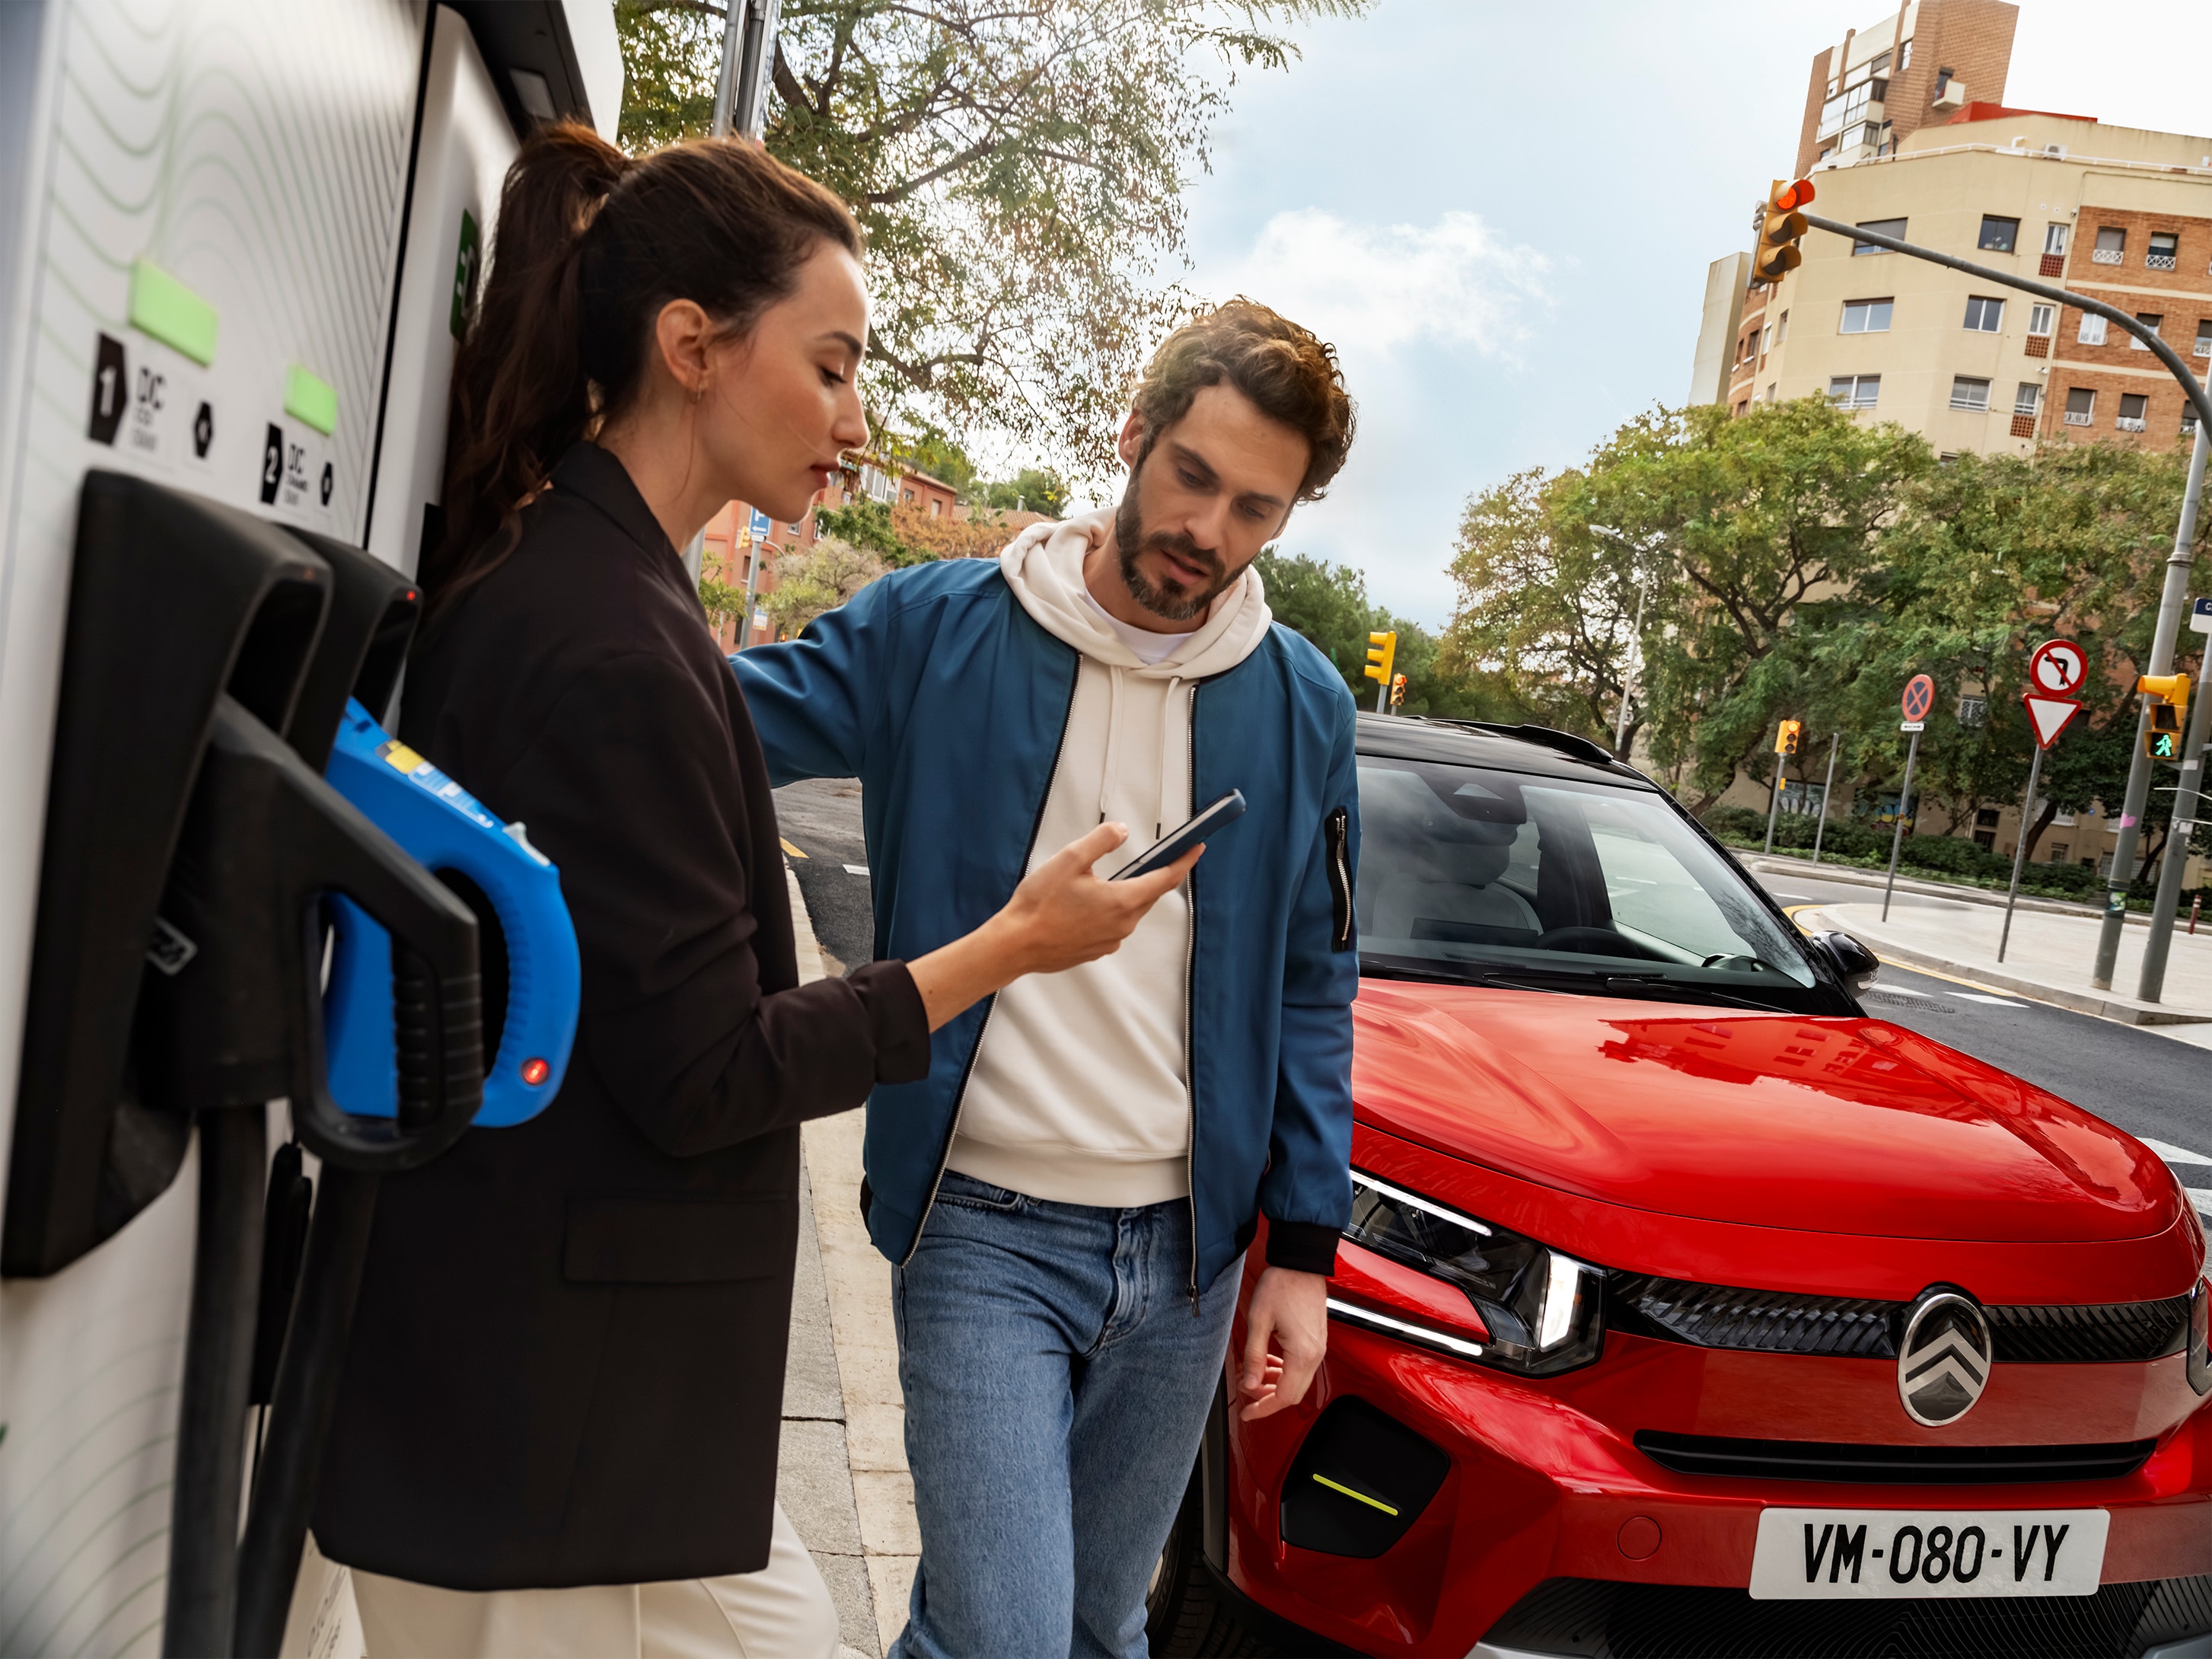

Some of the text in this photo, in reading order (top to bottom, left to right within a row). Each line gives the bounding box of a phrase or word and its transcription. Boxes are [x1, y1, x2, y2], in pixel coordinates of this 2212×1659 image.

[99, 365, 116, 416] 1
[265, 445, 279, 484] 2
[1804, 1524, 2070, 1584] VM-080-VY
